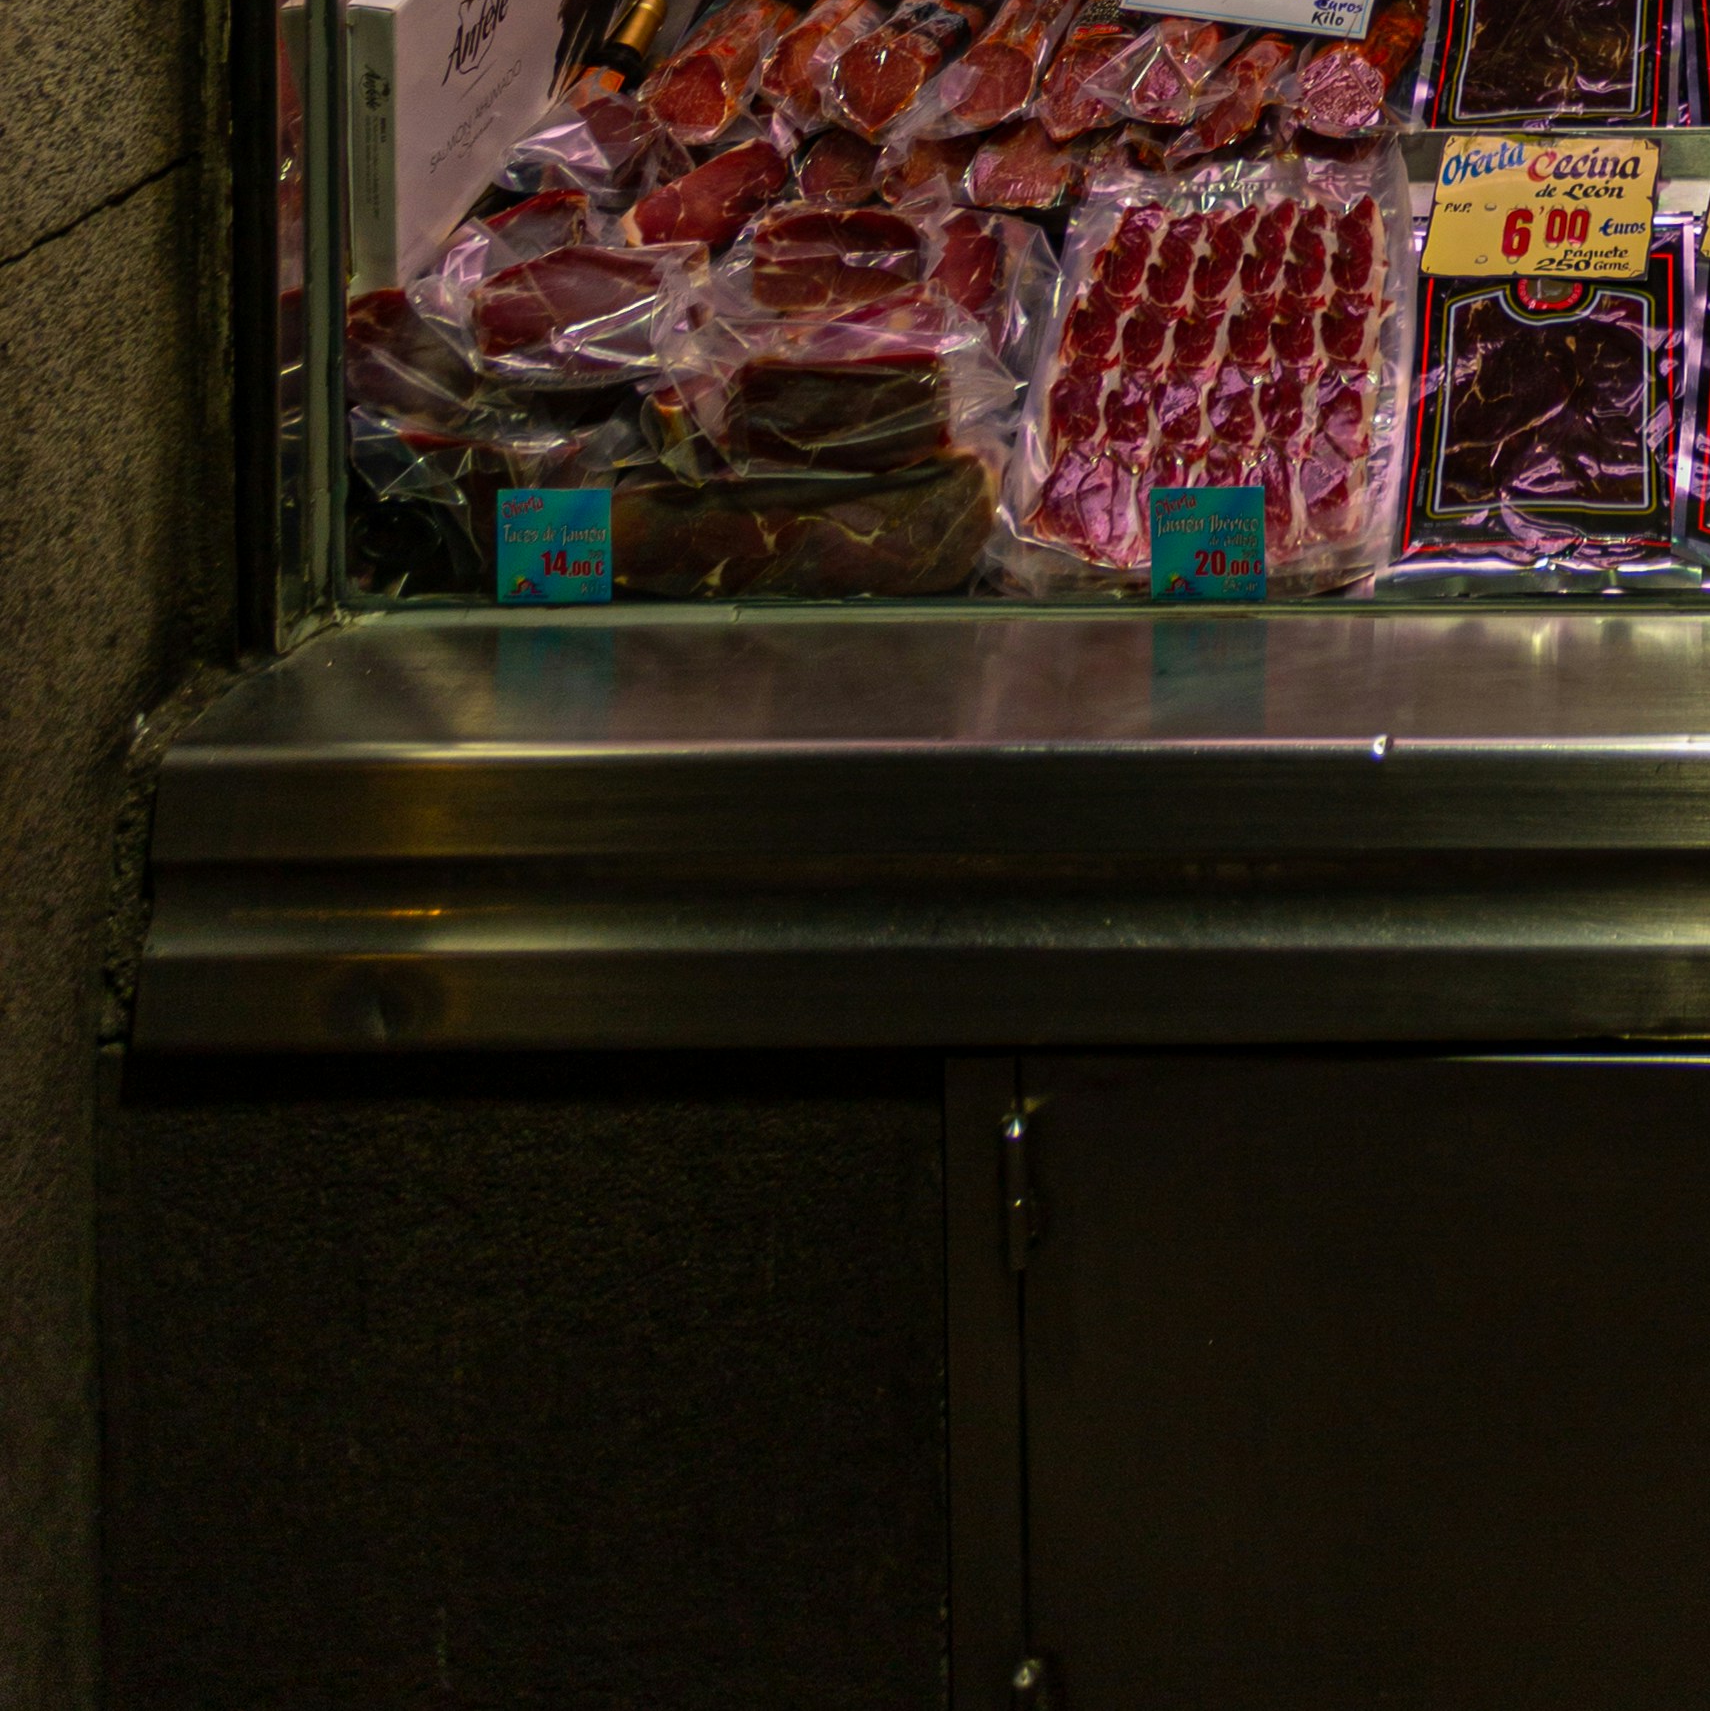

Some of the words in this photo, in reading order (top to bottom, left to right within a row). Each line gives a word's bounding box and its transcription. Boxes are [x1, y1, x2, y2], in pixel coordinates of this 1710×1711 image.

[1310, 11, 1345, 28] Kilo
[1441, 141, 1530, 187] Oferta
[1526, 146, 1644, 183] Cecina
[1534, 183, 1558, 198] de
[1562, 180, 1627, 201] León
[1501, 205, 1592, 259] 6'00
[1533, 258, 1591, 272] 250
